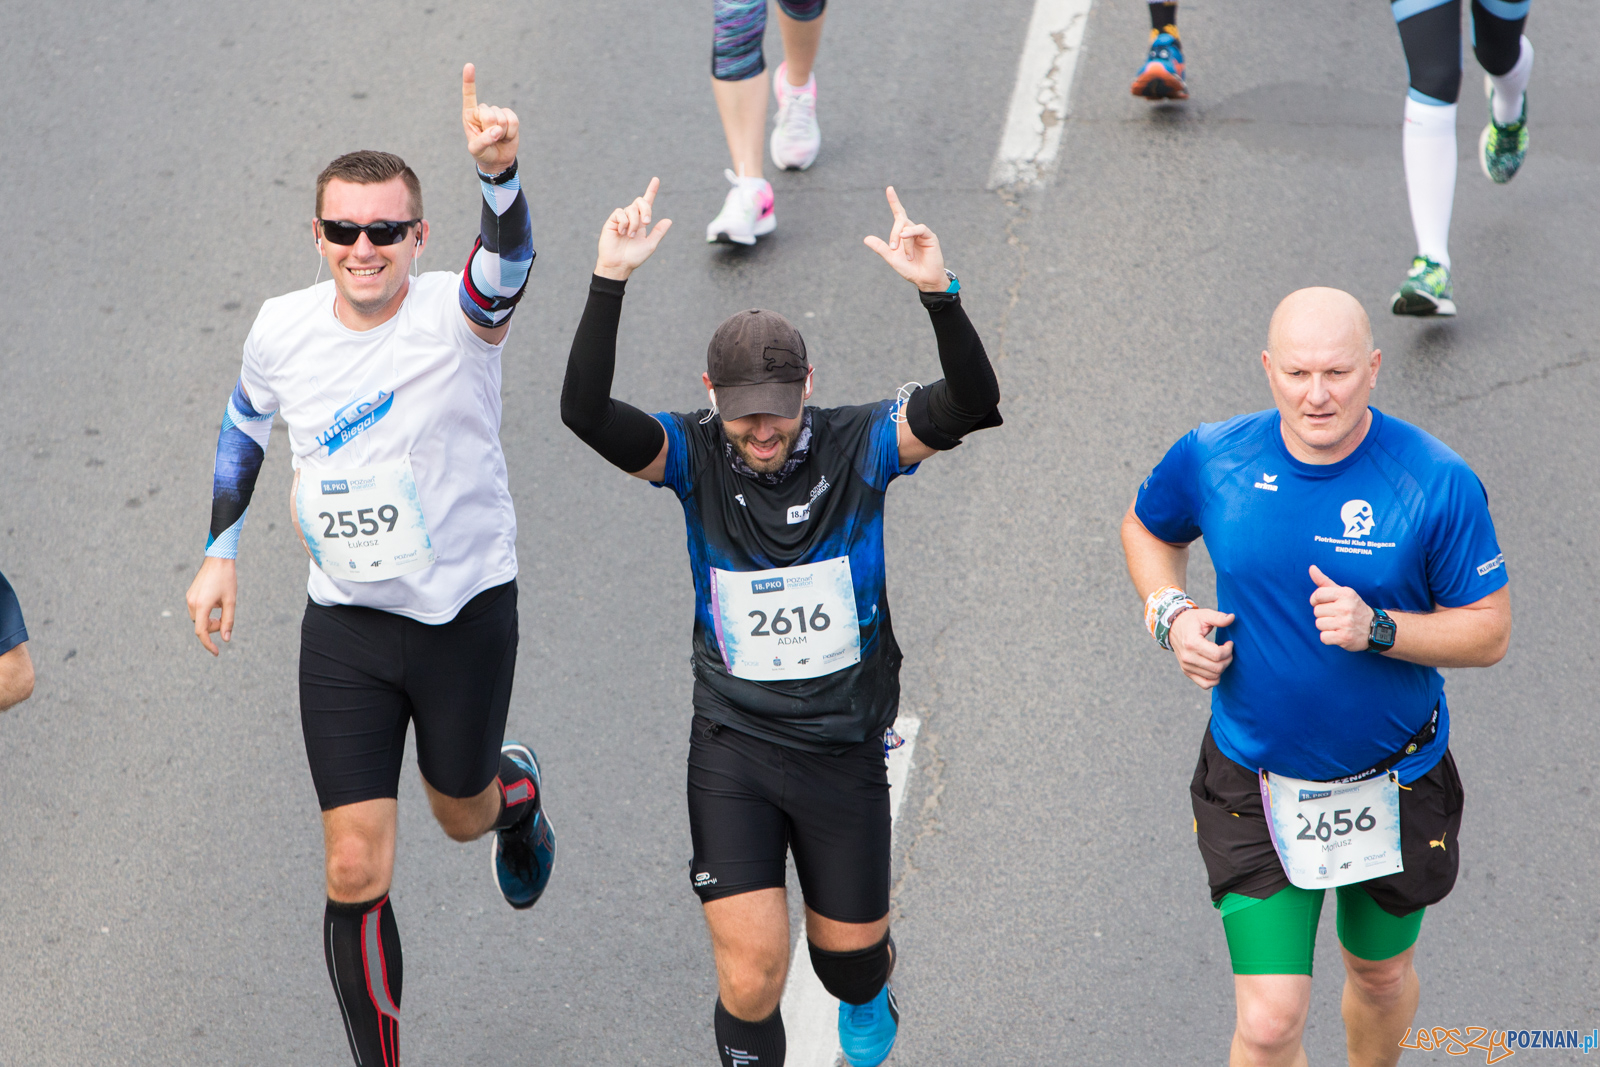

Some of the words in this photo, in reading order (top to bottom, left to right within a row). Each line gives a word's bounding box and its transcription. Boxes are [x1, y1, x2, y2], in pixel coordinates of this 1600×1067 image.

[340, 411, 376, 443] Biega!
[1254, 482, 1279, 492] erima
[318, 504, 399, 539] 2559
[1314, 535, 1350, 546] Piotrkowski
[1367, 541, 1396, 549] Biegacza
[1335, 546, 1373, 556] ENDORFINA
[748, 603, 831, 637] 2616
[777, 636, 808, 646] ADAM
[1296, 806, 1377, 843] 2656
[1321, 838, 1353, 853] Mariusz
